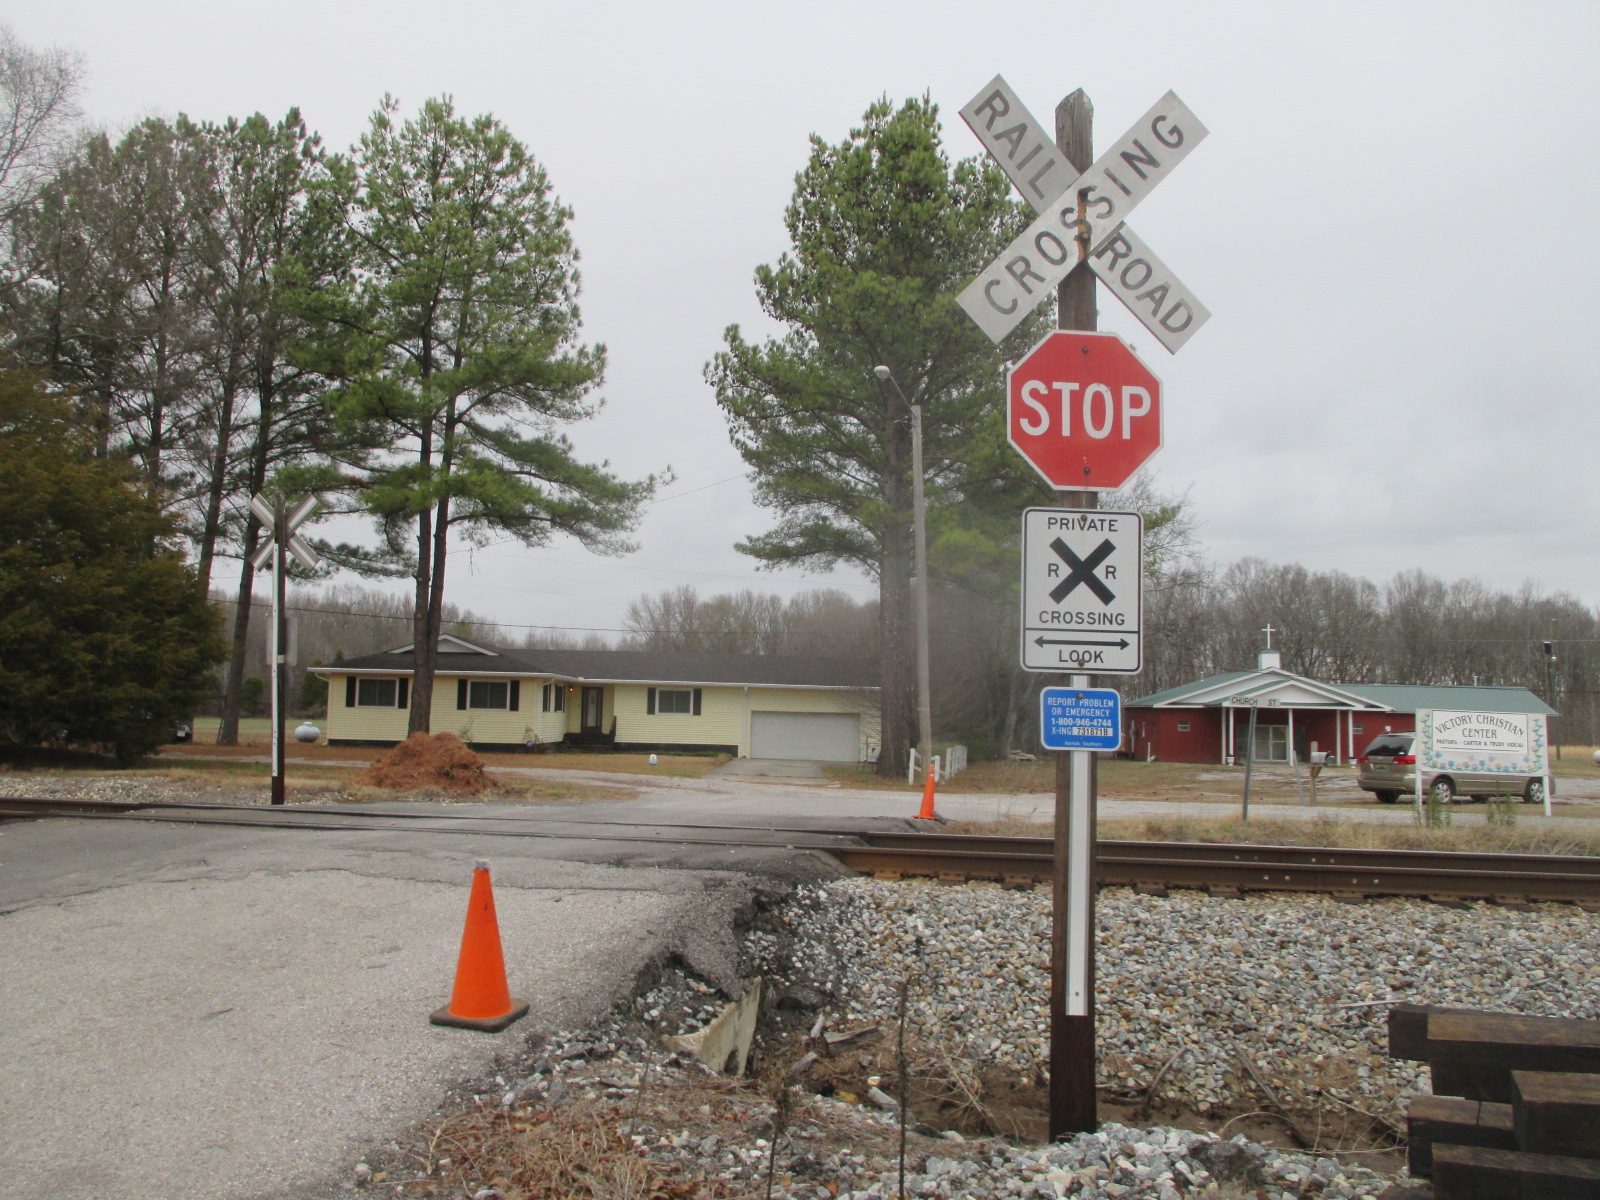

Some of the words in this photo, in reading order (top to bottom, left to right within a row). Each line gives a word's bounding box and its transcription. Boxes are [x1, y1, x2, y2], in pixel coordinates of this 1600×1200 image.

[973, 88, 1056, 200] RAIL
[1094, 231, 1194, 333] ROAD
[984, 115, 1184, 315] CROSSING
[1020, 380, 1151, 440] STOP
[1047, 517, 1118, 532] PRIVATE
[1047, 563, 1060, 578] R
[1105, 565, 1117, 579] R
[1039, 610, 1126, 626] CROSSING
[1059, 650, 1104, 664] LOOK
[1047, 697, 1076, 706] REPORT
[1079, 699, 1114, 708] PROBLEM
[1231, 697, 1258, 706] CHURCH
[1051, 707, 1062, 716] OR
[1066, 708, 1110, 717] EMERGENCY
[1051, 717, 1112, 727] 1-800-946-4744
[1435, 714, 1473, 734] VICTORY
[1476, 714, 1525, 737] CHRISTIAN
[1051, 727, 1072, 735] X-ING
[1462, 728, 1497, 739] CENTER
